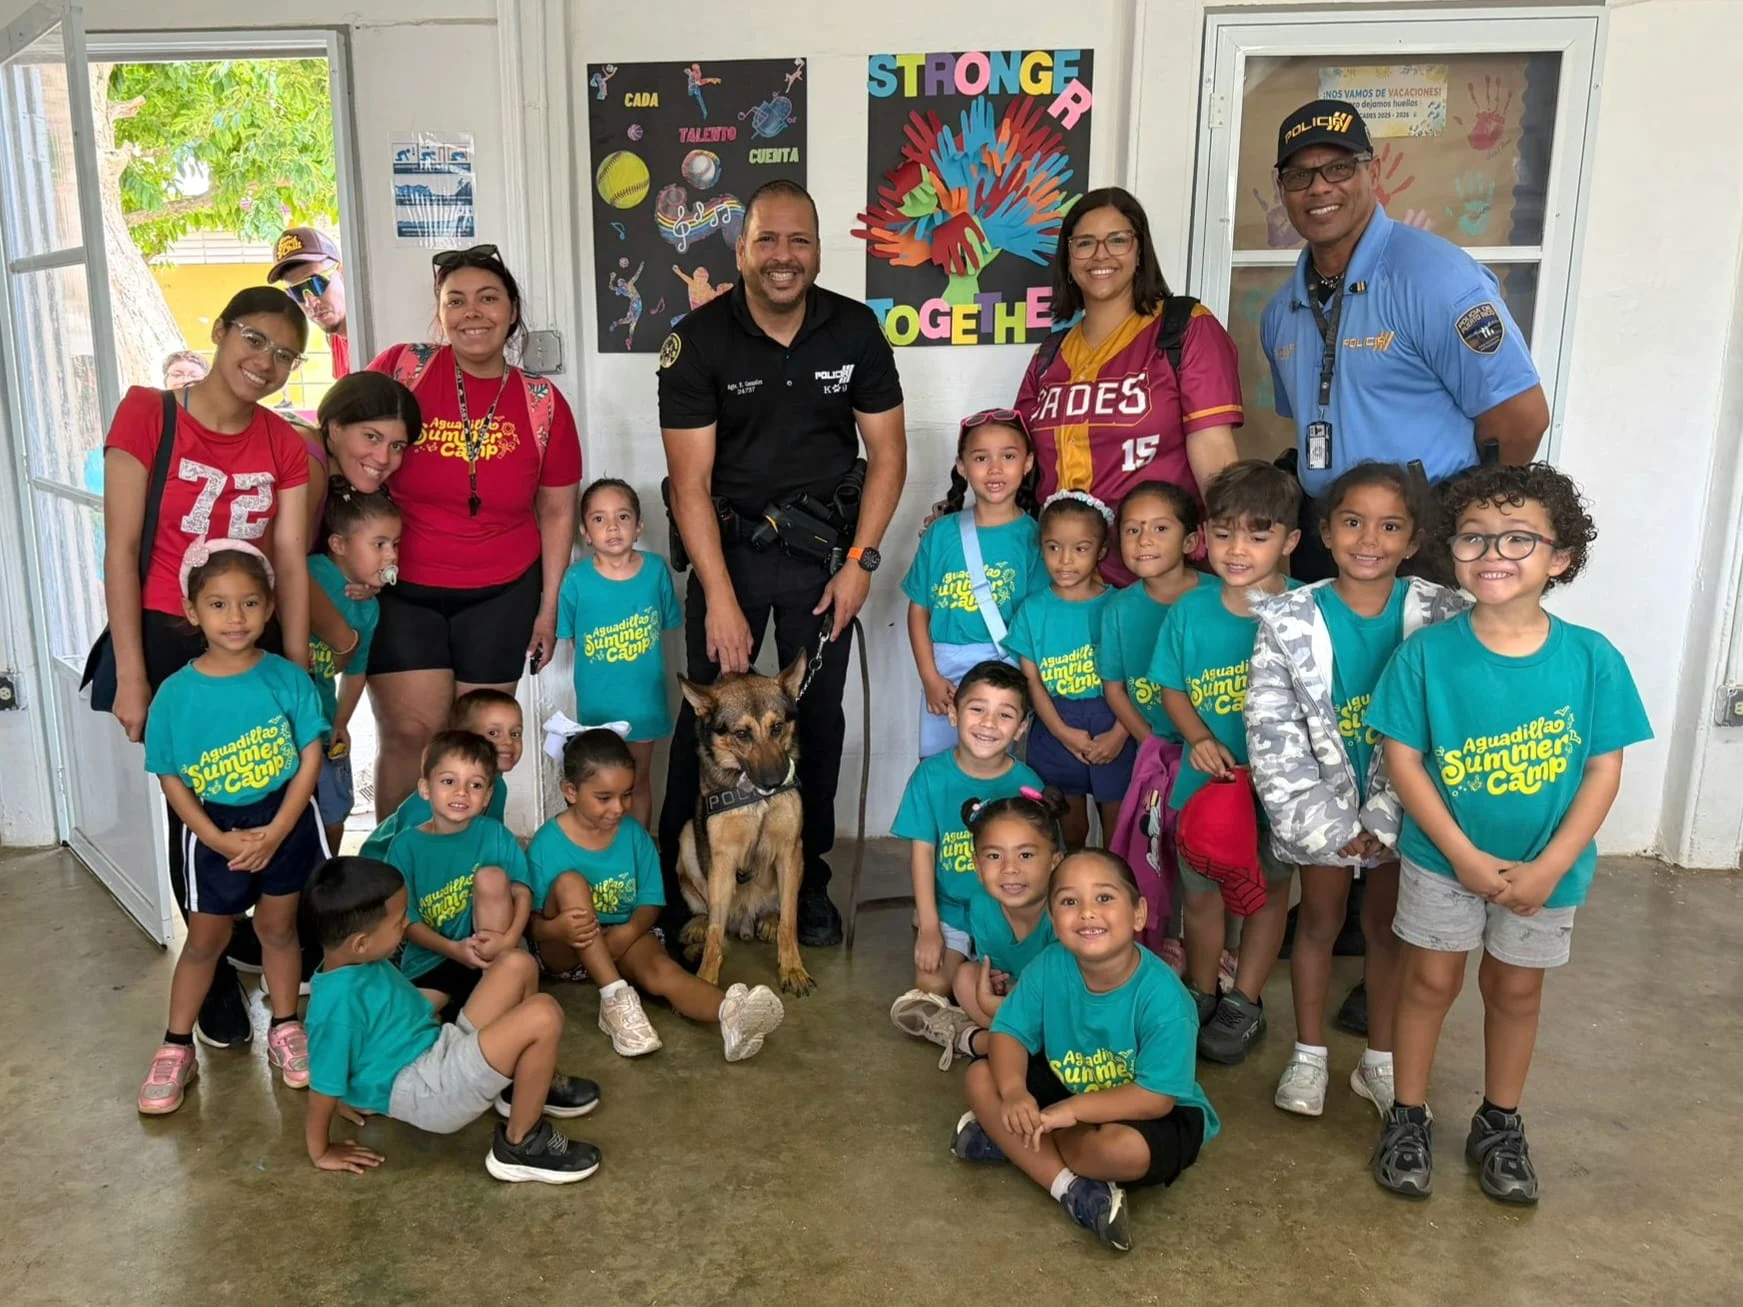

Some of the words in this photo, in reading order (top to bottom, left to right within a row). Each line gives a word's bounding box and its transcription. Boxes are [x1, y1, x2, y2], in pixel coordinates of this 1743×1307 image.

[624, 92, 660, 108] CADA
[867, 50, 1093, 131] STRONGER
[1344, 88, 1373, 98] VAMOS
[1376, 88, 1386, 97] DE
[1388, 87, 1441, 97] VACACIONES!
[1361, 100, 1391, 110] dejamos
[679, 126, 737, 143] TALENTO
[749, 147, 799, 164] CUENTA
[866, 286, 1080, 346] TOGETHE
[1121, 434, 1161, 472] 15
[178, 457, 276, 540] 72
[593, 613, 650, 638] Aguadilla
[585, 624, 653, 657] Summer
[606, 638, 651, 663] Camp
[1041, 660, 1095, 682] umme
[1201, 660, 1249, 681] Aguadi
[1215, 695, 1246, 715] Ca
[200, 726, 279, 767] Aguadilla
[1463, 716, 1566, 754] Aguadilla
[187, 737, 286, 794] Summer
[225, 755, 285, 793] Camp
[1441, 734, 1570, 786] Summer
[1486, 756, 1568, 795] Camp
[709, 788, 751, 810] POL
